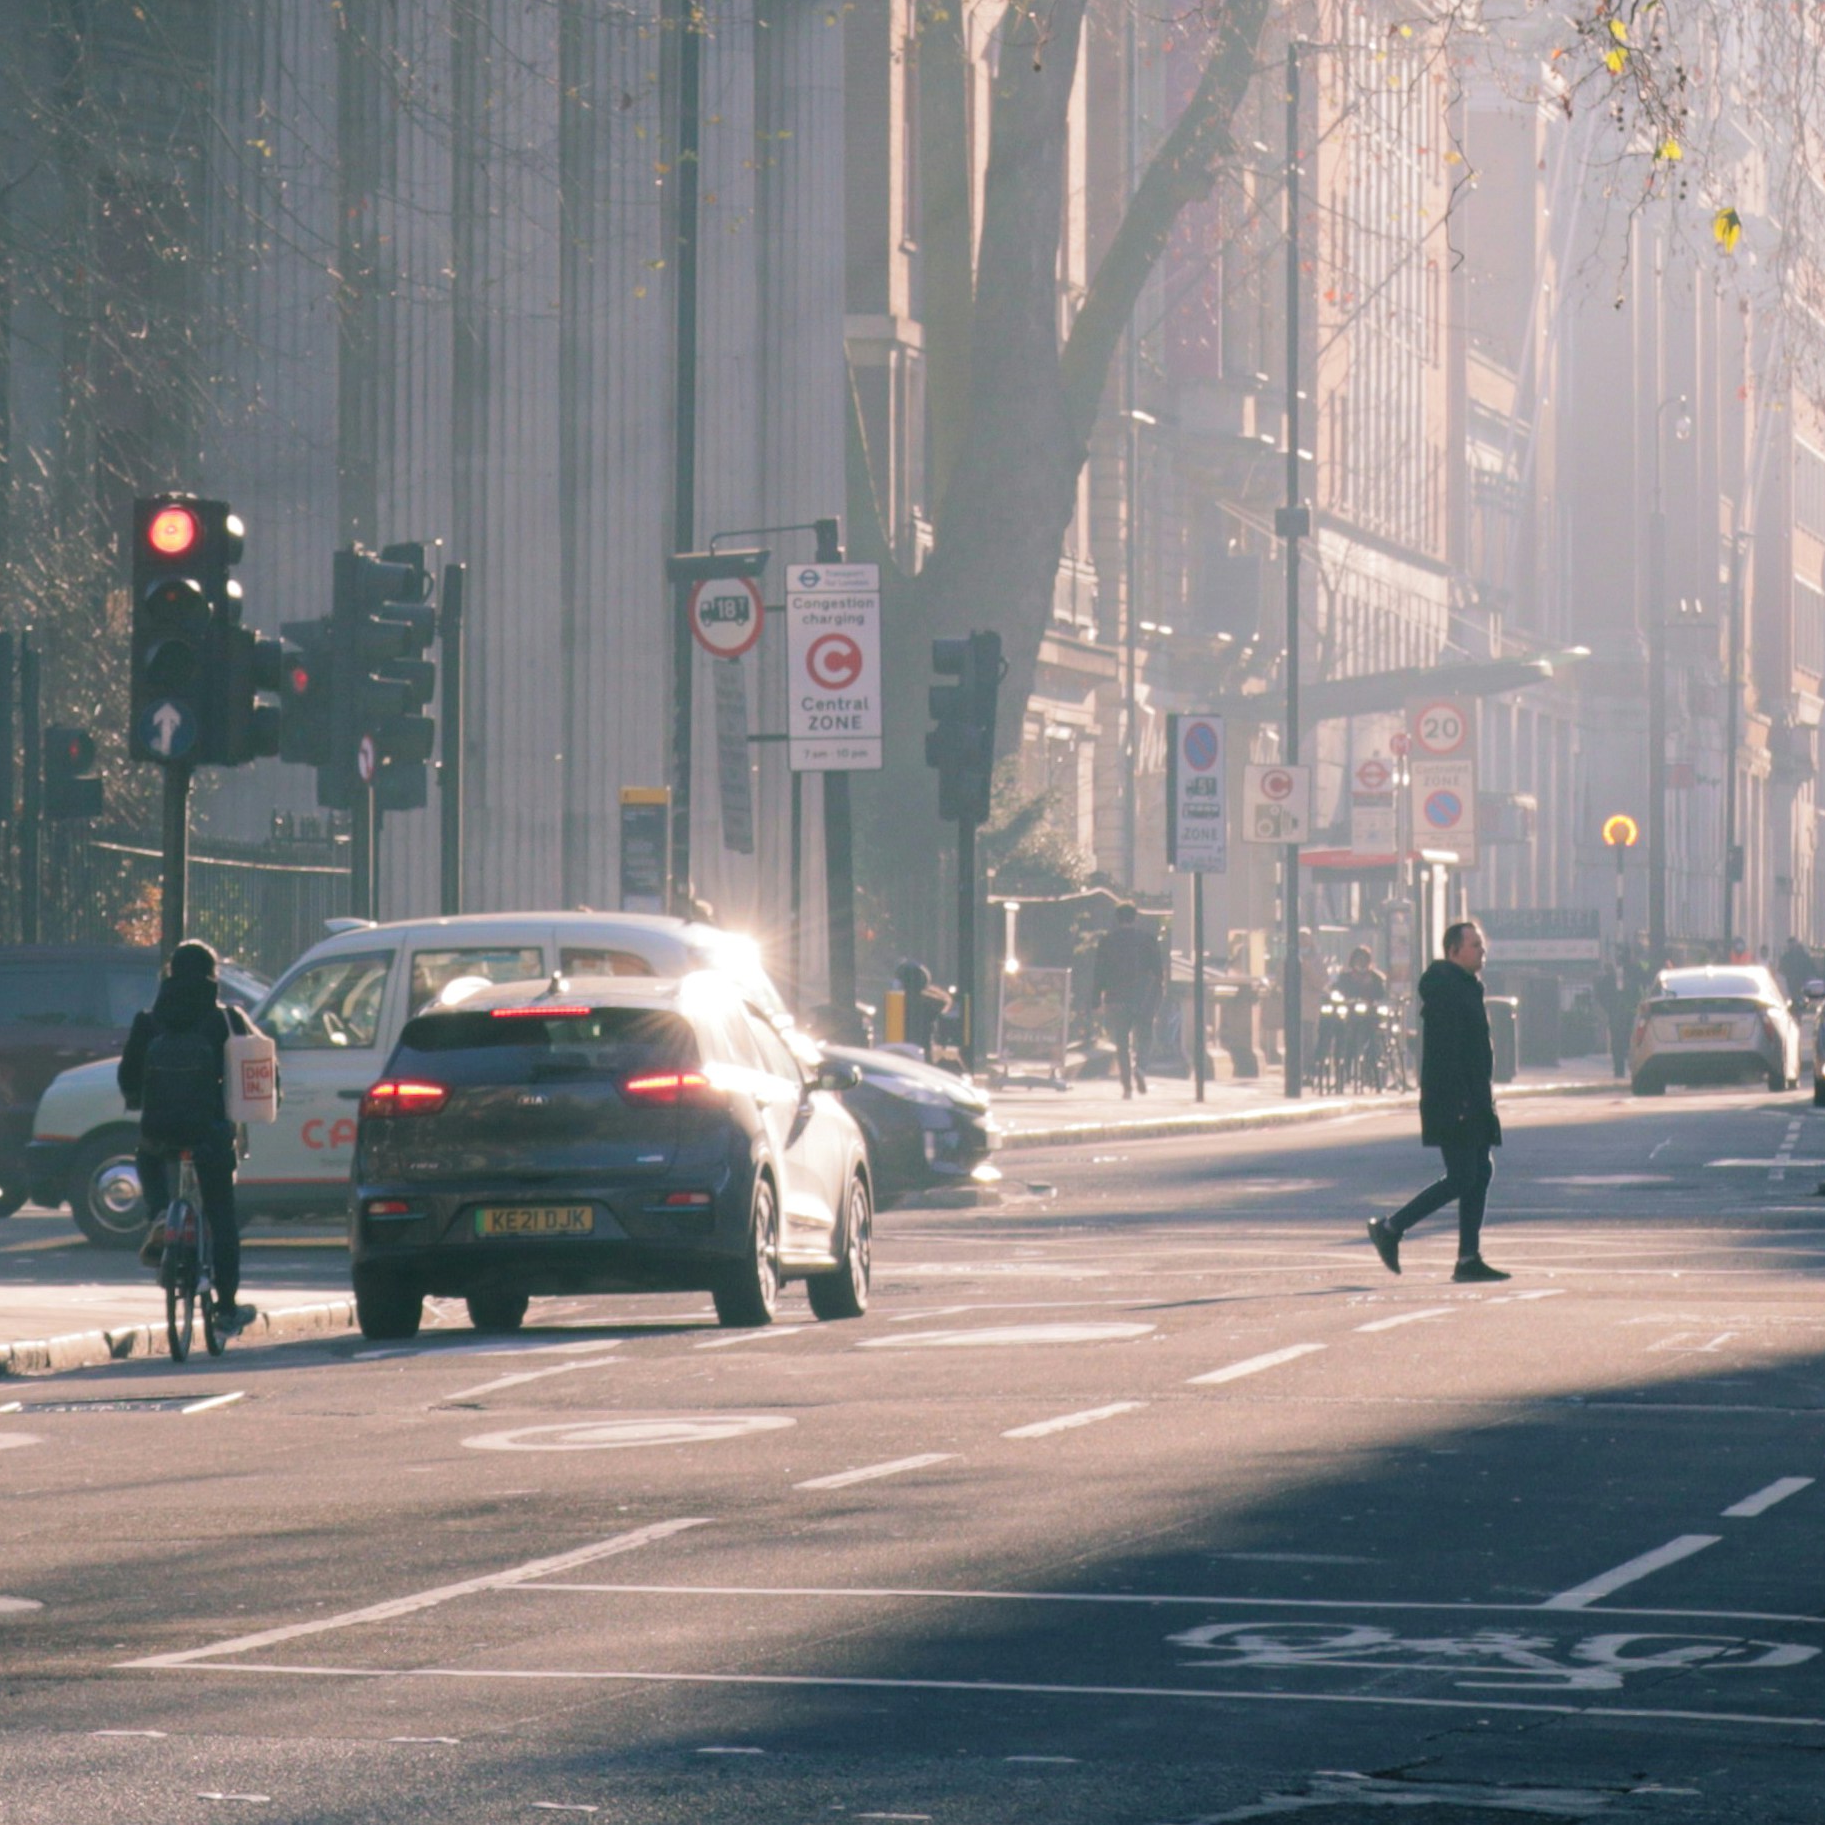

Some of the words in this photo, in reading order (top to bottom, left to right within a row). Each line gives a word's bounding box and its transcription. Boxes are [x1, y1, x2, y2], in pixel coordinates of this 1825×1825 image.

[792, 597, 875, 611] Congestion
[801, 613, 865, 626] charging
[801, 697, 869, 712] Central
[808, 716, 863, 730] ZONE
[1424, 718, 1459, 739] 20
[836, 748, 849, 758] 10
[851, 750, 869, 760] pm
[1423, 776, 1460, 787] ZONE
[1182, 827, 1218, 840] ZONE
[246, 1065, 271, 1079] DIG
[246, 1080, 265, 1093] IN.
[301, 1118, 357, 1150] CA
[491, 1211, 538, 1232] KE21
[545, 1210, 586, 1230] DJK
